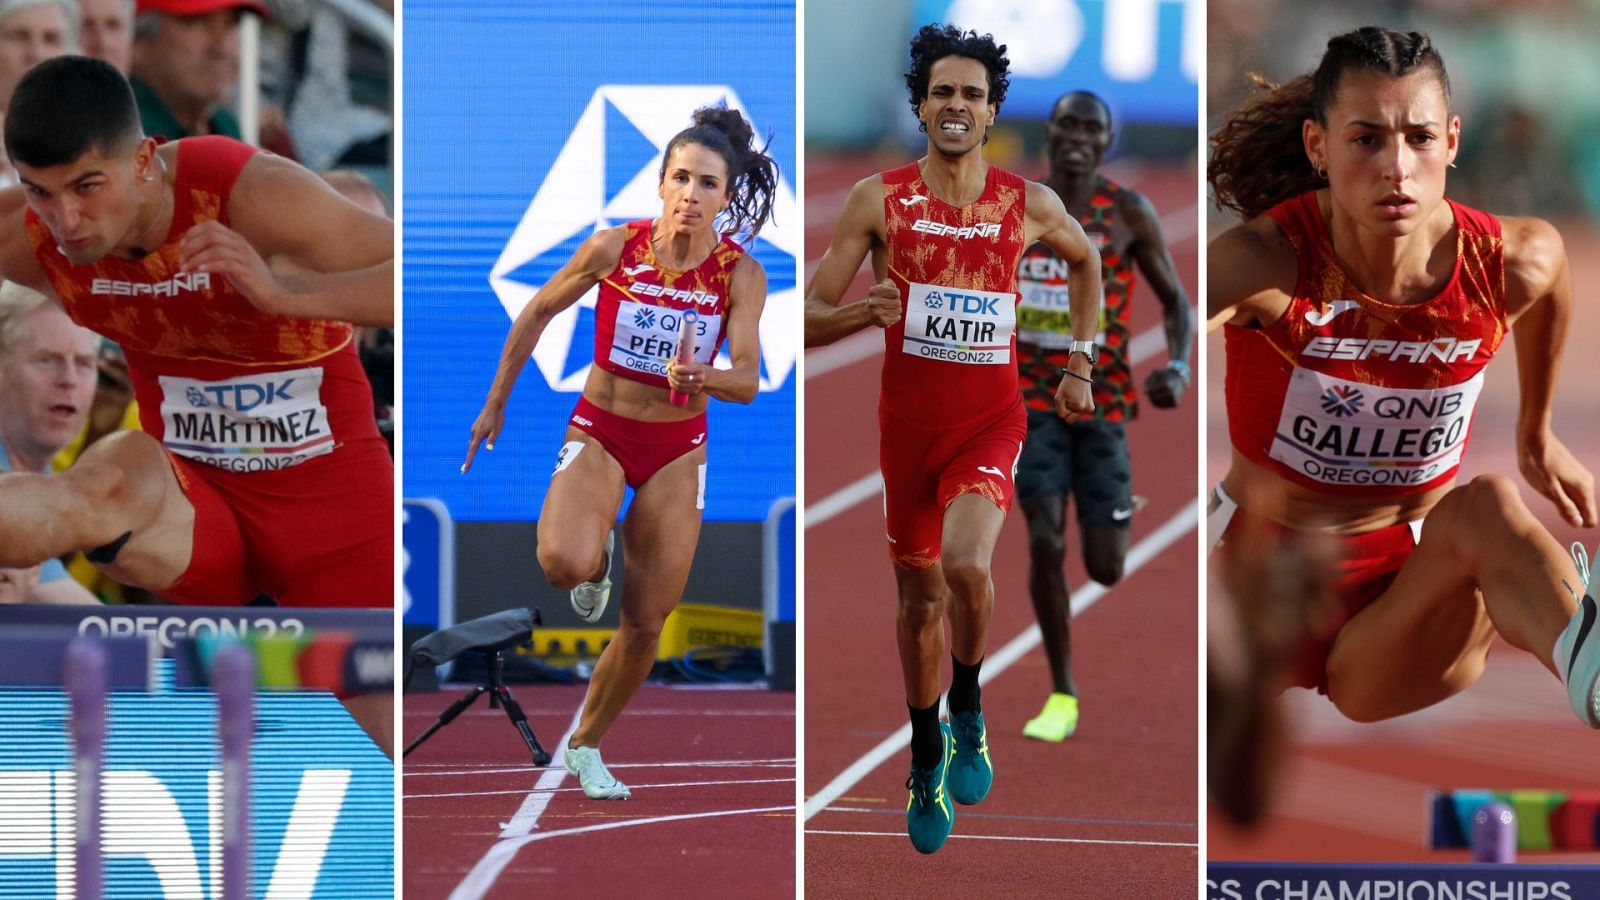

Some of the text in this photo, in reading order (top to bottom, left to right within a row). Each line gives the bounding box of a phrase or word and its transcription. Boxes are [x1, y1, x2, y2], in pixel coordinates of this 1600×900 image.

[910, 219, 1002, 240] ESPAÑA
[91, 272, 211, 297] ESPAÑA
[628, 281, 719, 307] ESPAÑA
[943, 292, 1001, 316] TDK
[660, 314, 708, 337] QB
[925, 315, 997, 343] KATIR
[629, 334, 701, 359] PÉR
[920, 345, 995, 364] OREGON22
[1302, 336, 1483, 364] ESPAÑA
[625, 357, 669, 376] OREGO
[204, 378, 297, 412] TDK
[1373, 392, 1464, 419] QNB
[1292, 414, 1465, 458] GALLEGO
[1302, 460, 1440, 484] OREGON22
[1255, 879, 1573, 900] CHAMPIONSHIPS
